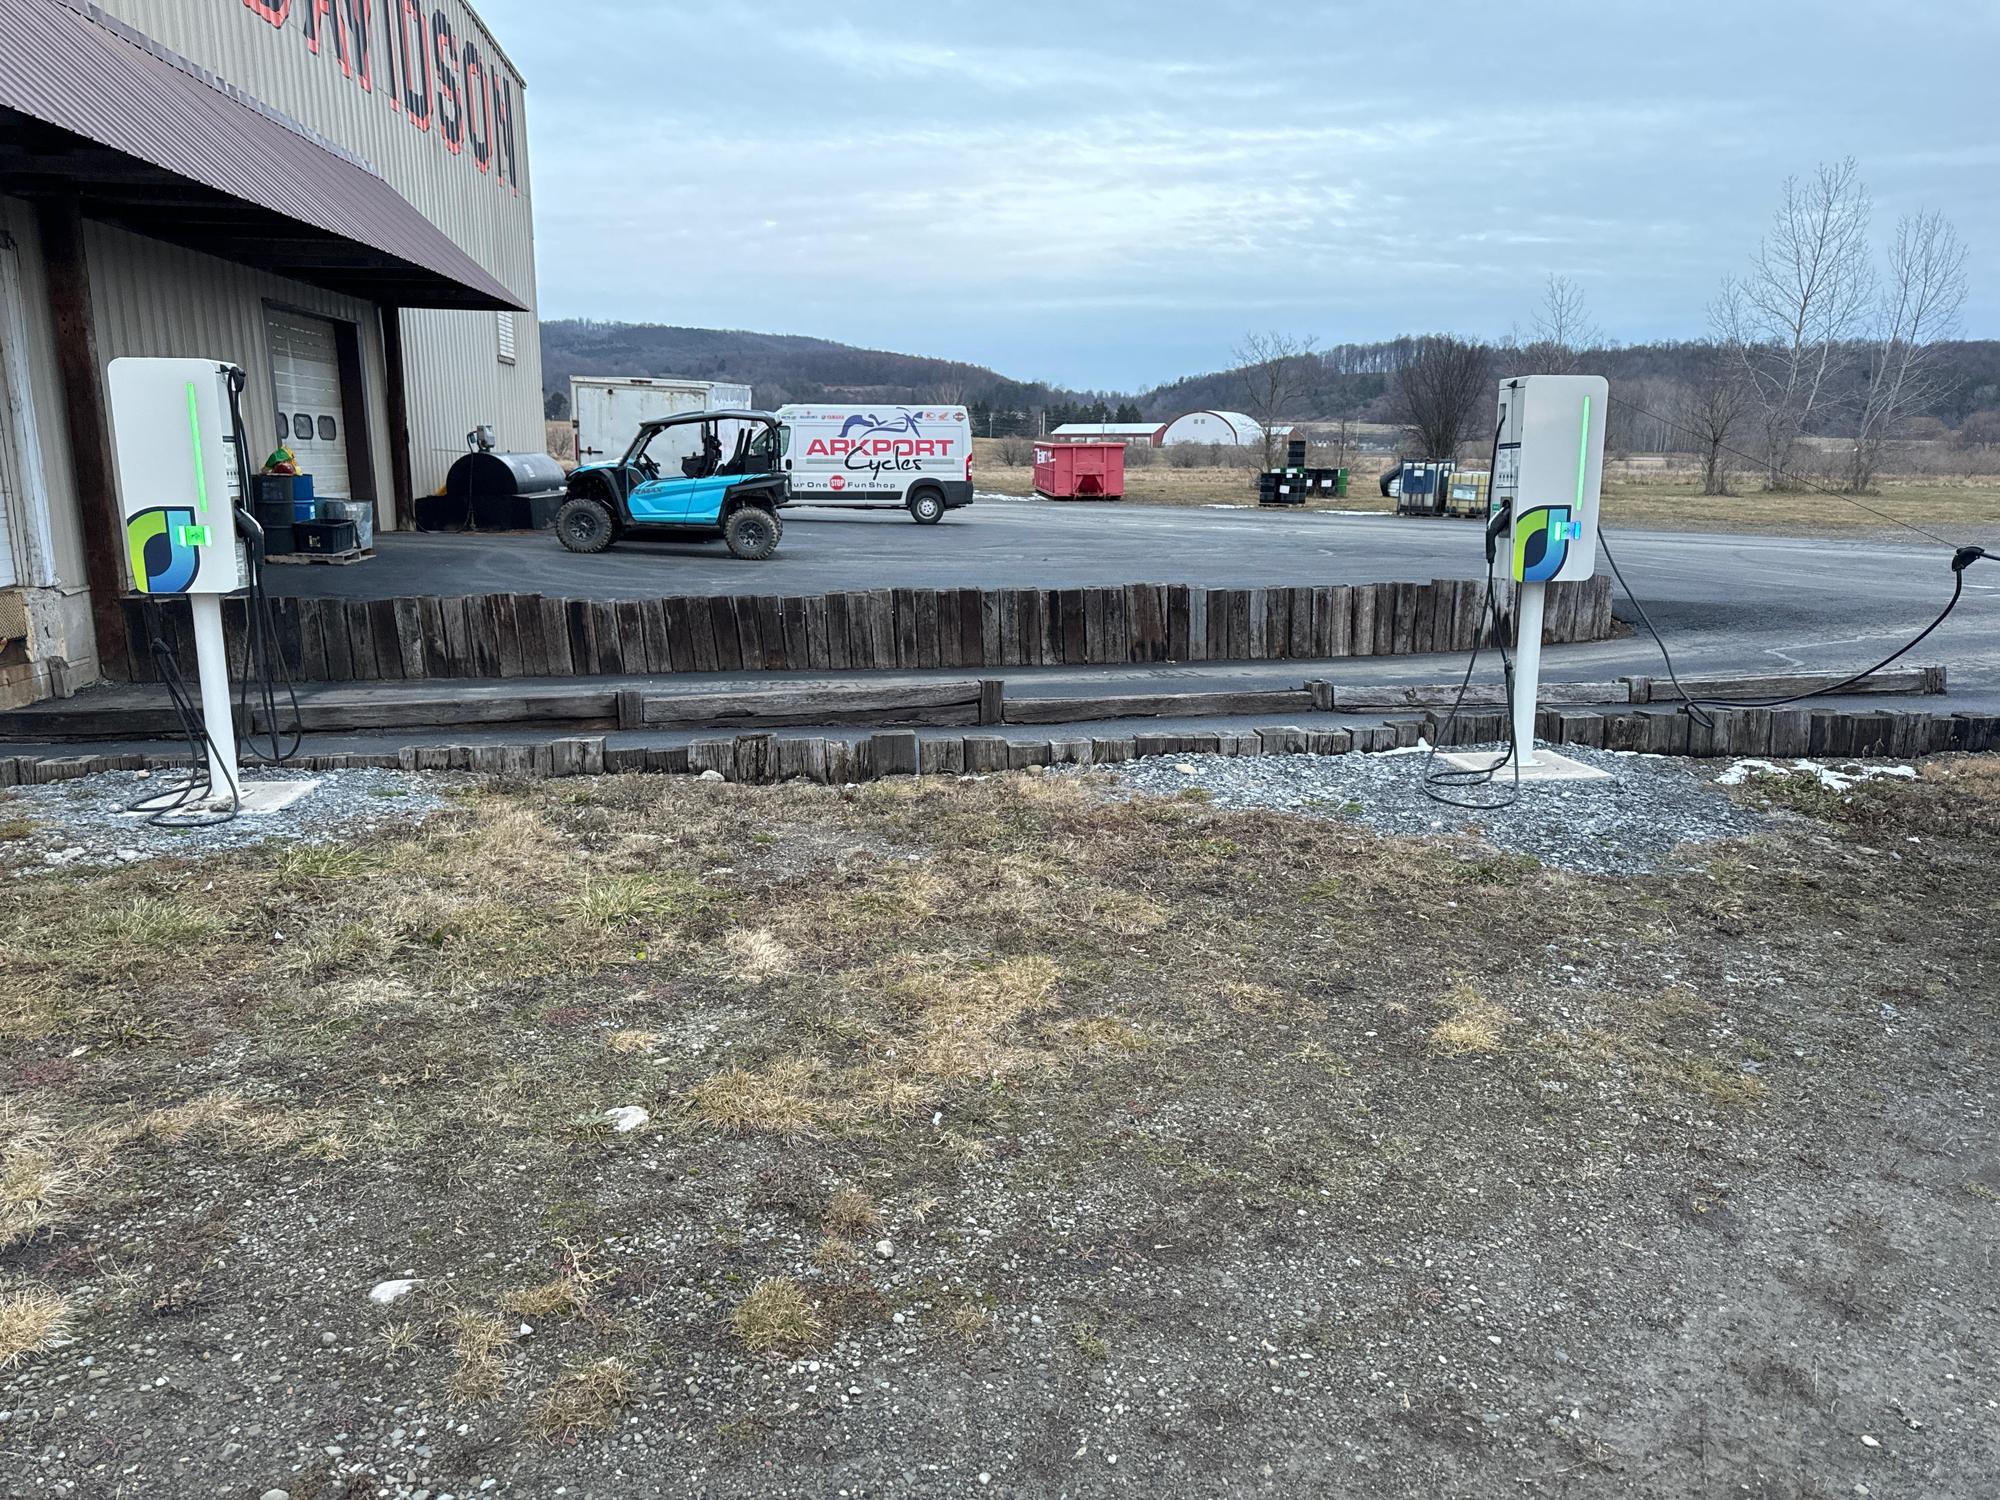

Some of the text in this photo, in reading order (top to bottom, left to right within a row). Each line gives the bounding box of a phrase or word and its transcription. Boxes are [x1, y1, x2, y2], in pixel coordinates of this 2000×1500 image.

[243, 0, 517, 197] VIDSON
[806, 439, 954, 456] ARKPORT
[845, 445, 922, 480] Cycles
